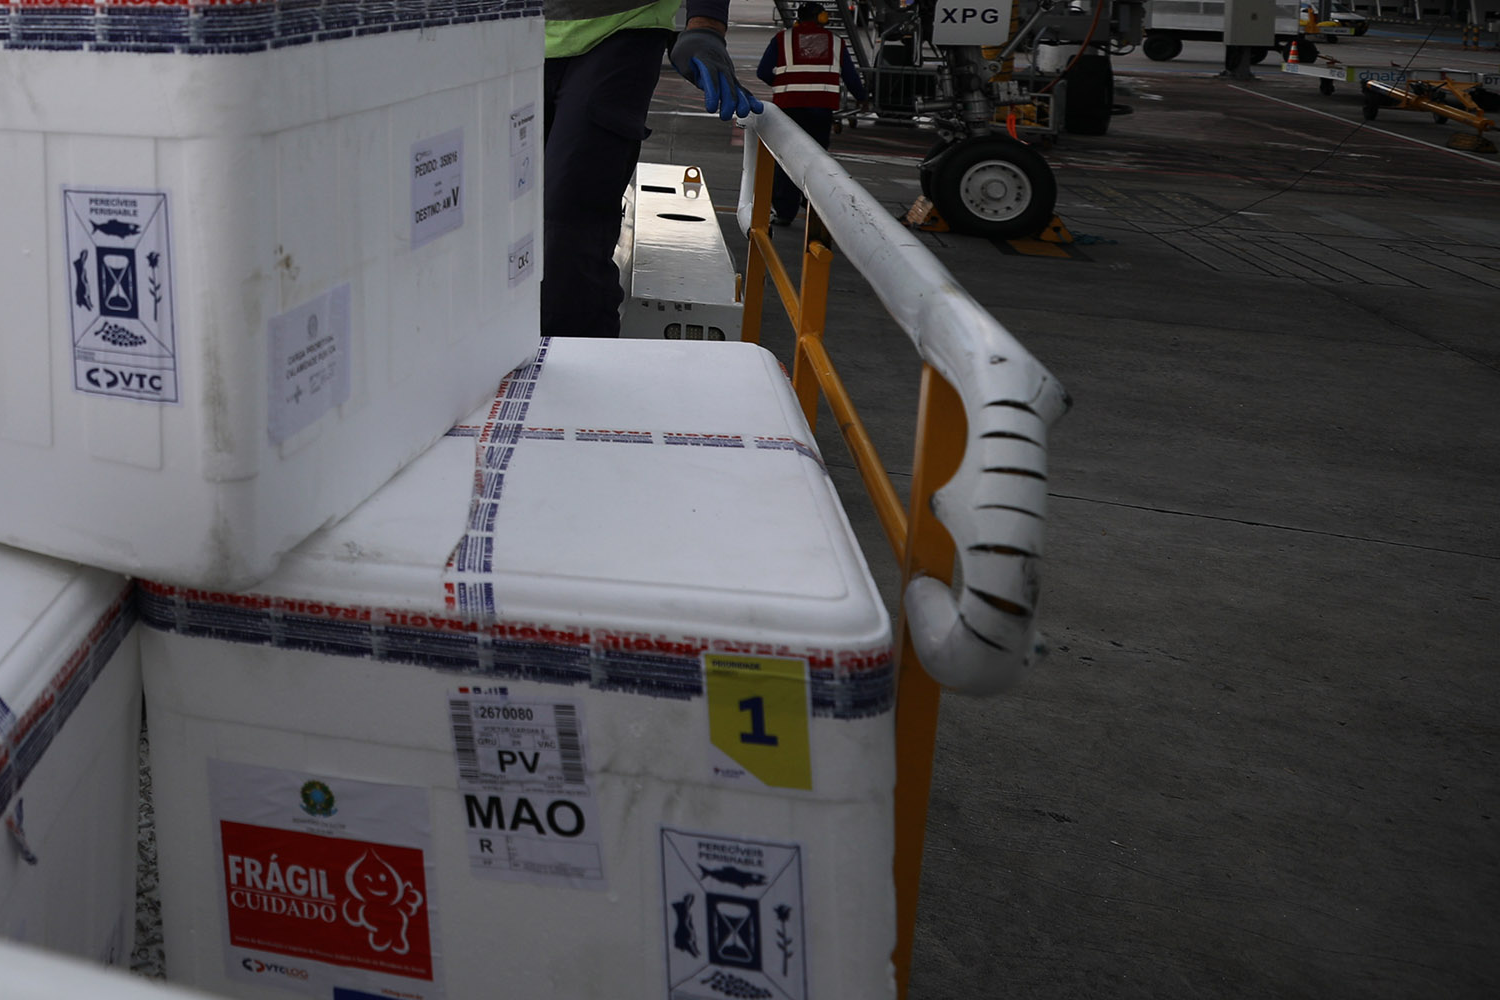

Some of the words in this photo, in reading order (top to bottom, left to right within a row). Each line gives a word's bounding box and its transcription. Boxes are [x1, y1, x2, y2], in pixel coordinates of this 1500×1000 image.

[940, 8, 999, 24] XPG
[1359, 70, 1406, 82] dnata
[415, 159, 438, 178] PEDIDO:
[89, 197, 138, 208] PERECÍVEIS
[452, 186, 459, 206] V
[89, 207, 138, 217] PERISHABLE
[415, 202, 442, 223] DESTINO:
[119, 371, 163, 391] VTC
[711, 660, 761, 671] PRIORIDADE
[479, 706, 534, 721] 2670080
[738, 696, 779, 747] 1
[497, 750, 540, 774] PV
[464, 794, 585, 838] MAO
[479, 839, 494, 854] R
[697, 841, 764, 858] PERECÍVEIS
[698, 851, 764, 867] PERISHABLE
[228, 853, 336, 900] FRÁGIL
[230, 890, 337, 923] CUIDADO
[265, 964, 308, 979] VTCLOG
